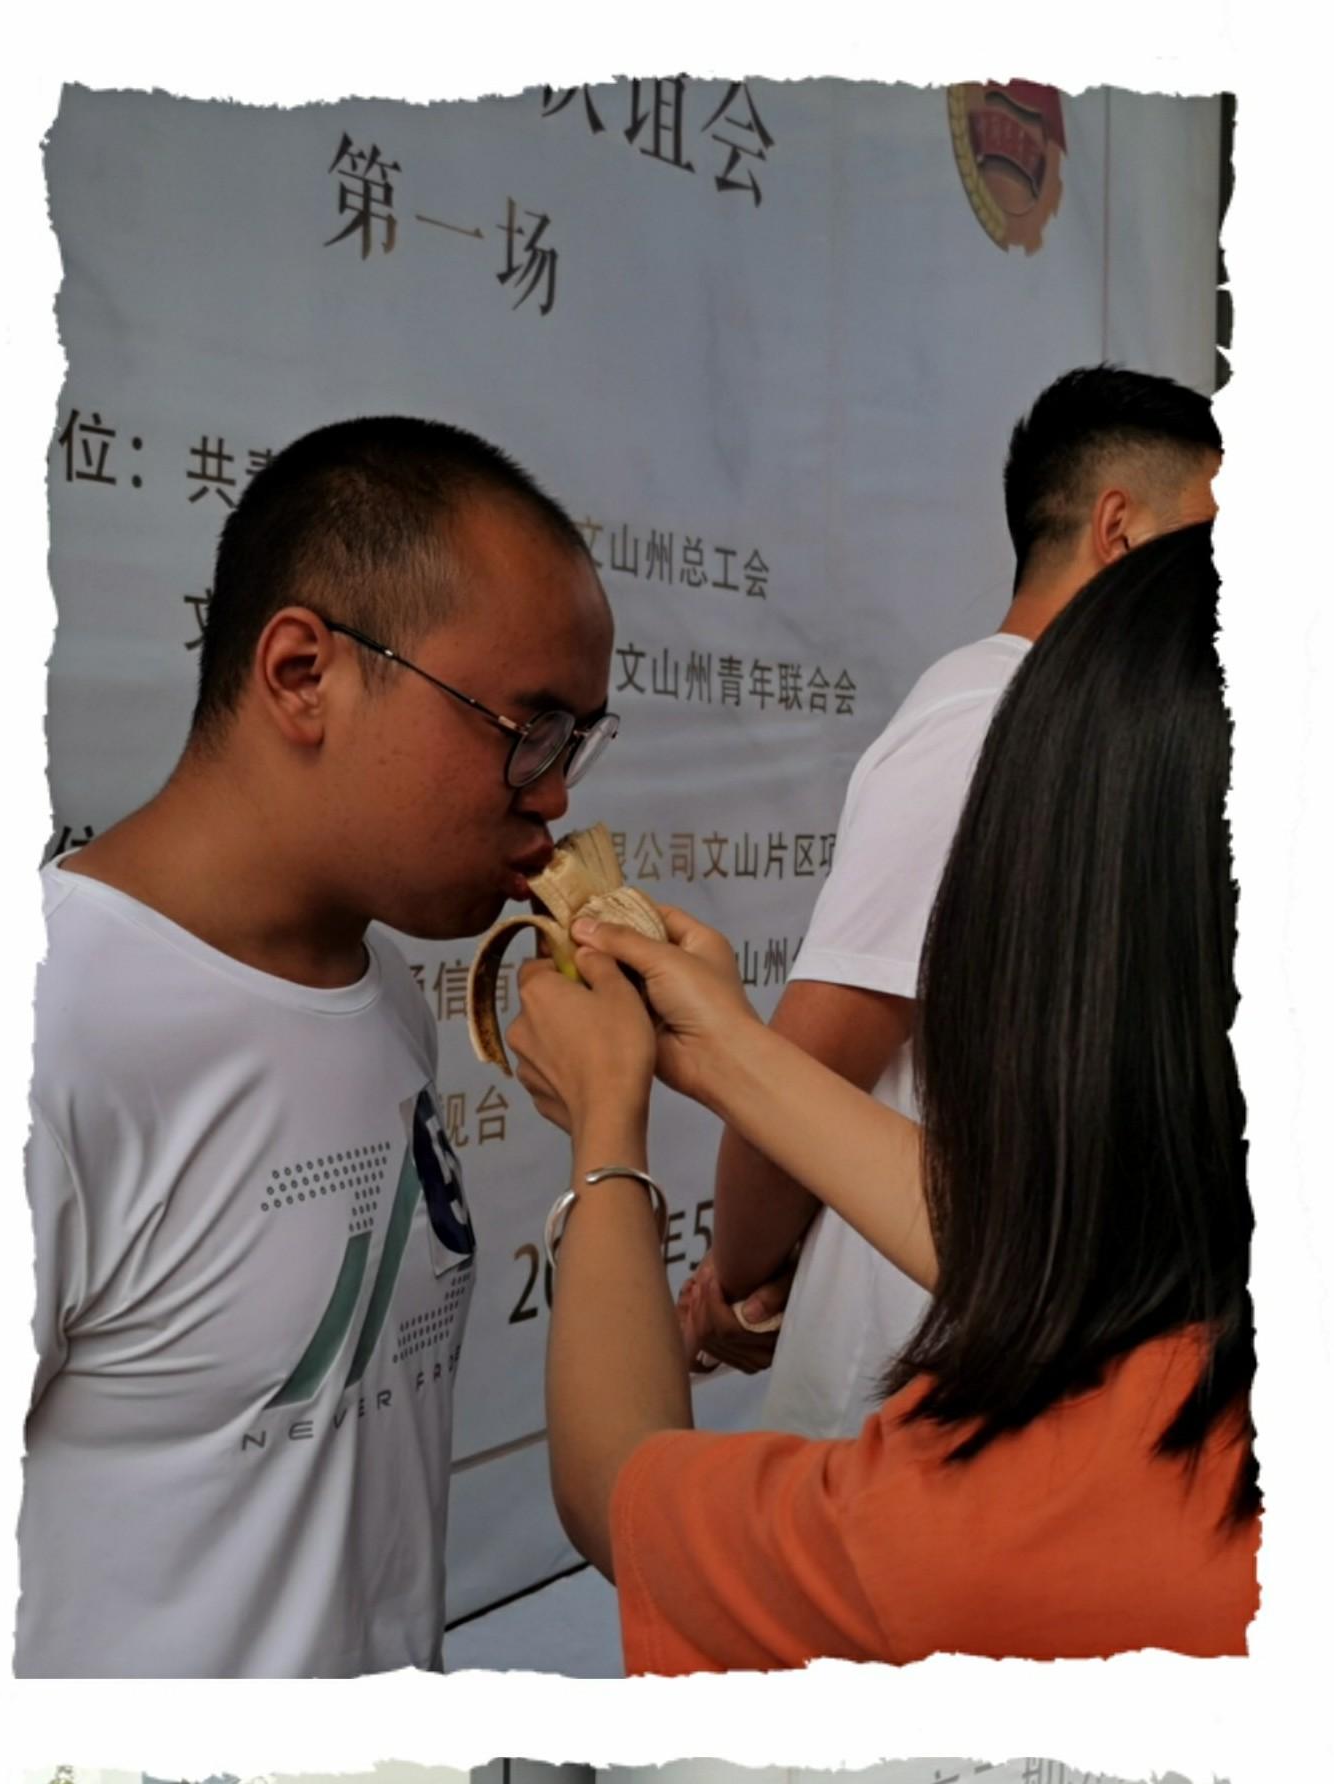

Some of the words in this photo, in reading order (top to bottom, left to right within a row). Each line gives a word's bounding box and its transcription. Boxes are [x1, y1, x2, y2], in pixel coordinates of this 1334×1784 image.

[324, 131, 558, 316] 第一场
[616, 642, 857, 716] 文山州青年联合会
[242, 1389, 392, 1451] NEVER
